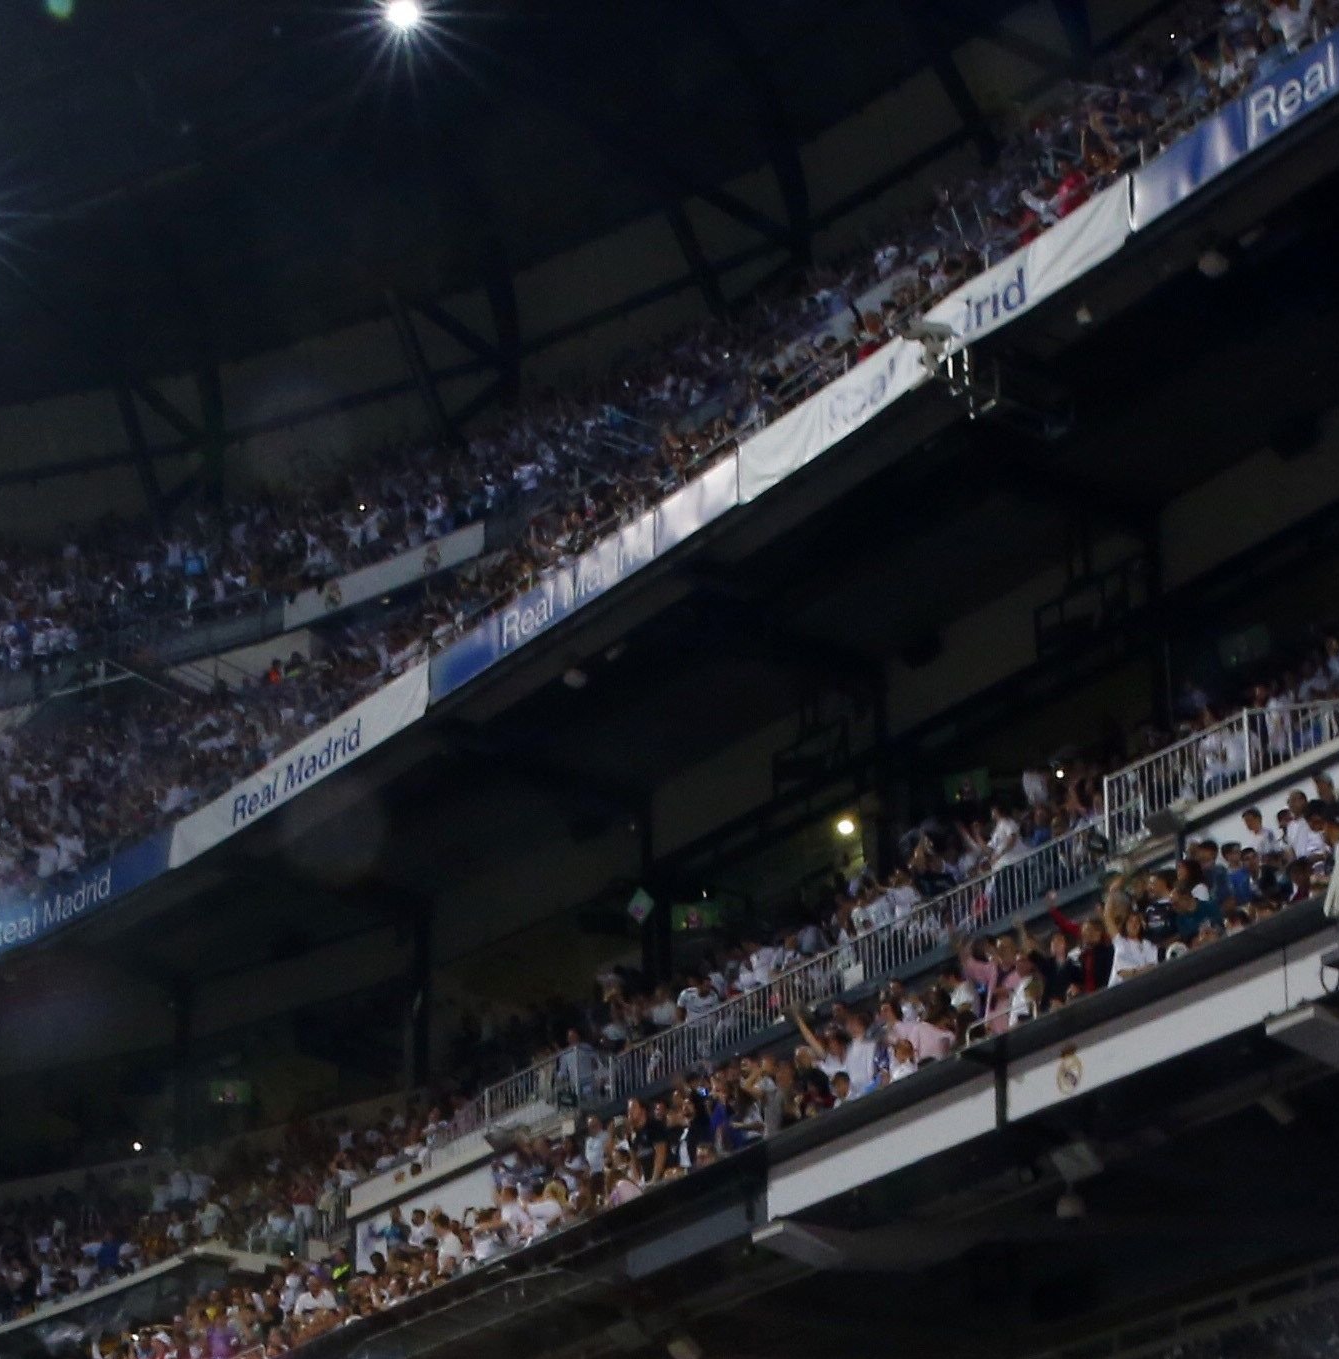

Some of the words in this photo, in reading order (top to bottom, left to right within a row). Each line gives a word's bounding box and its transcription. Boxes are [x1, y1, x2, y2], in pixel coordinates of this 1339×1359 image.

[1247, 42, 1337, 149] Real
[503, 580, 555, 649] Real
[233, 772, 279, 827] Real
[284, 717, 362, 793] Madrid
[43, 867, 112, 929] Madrid
